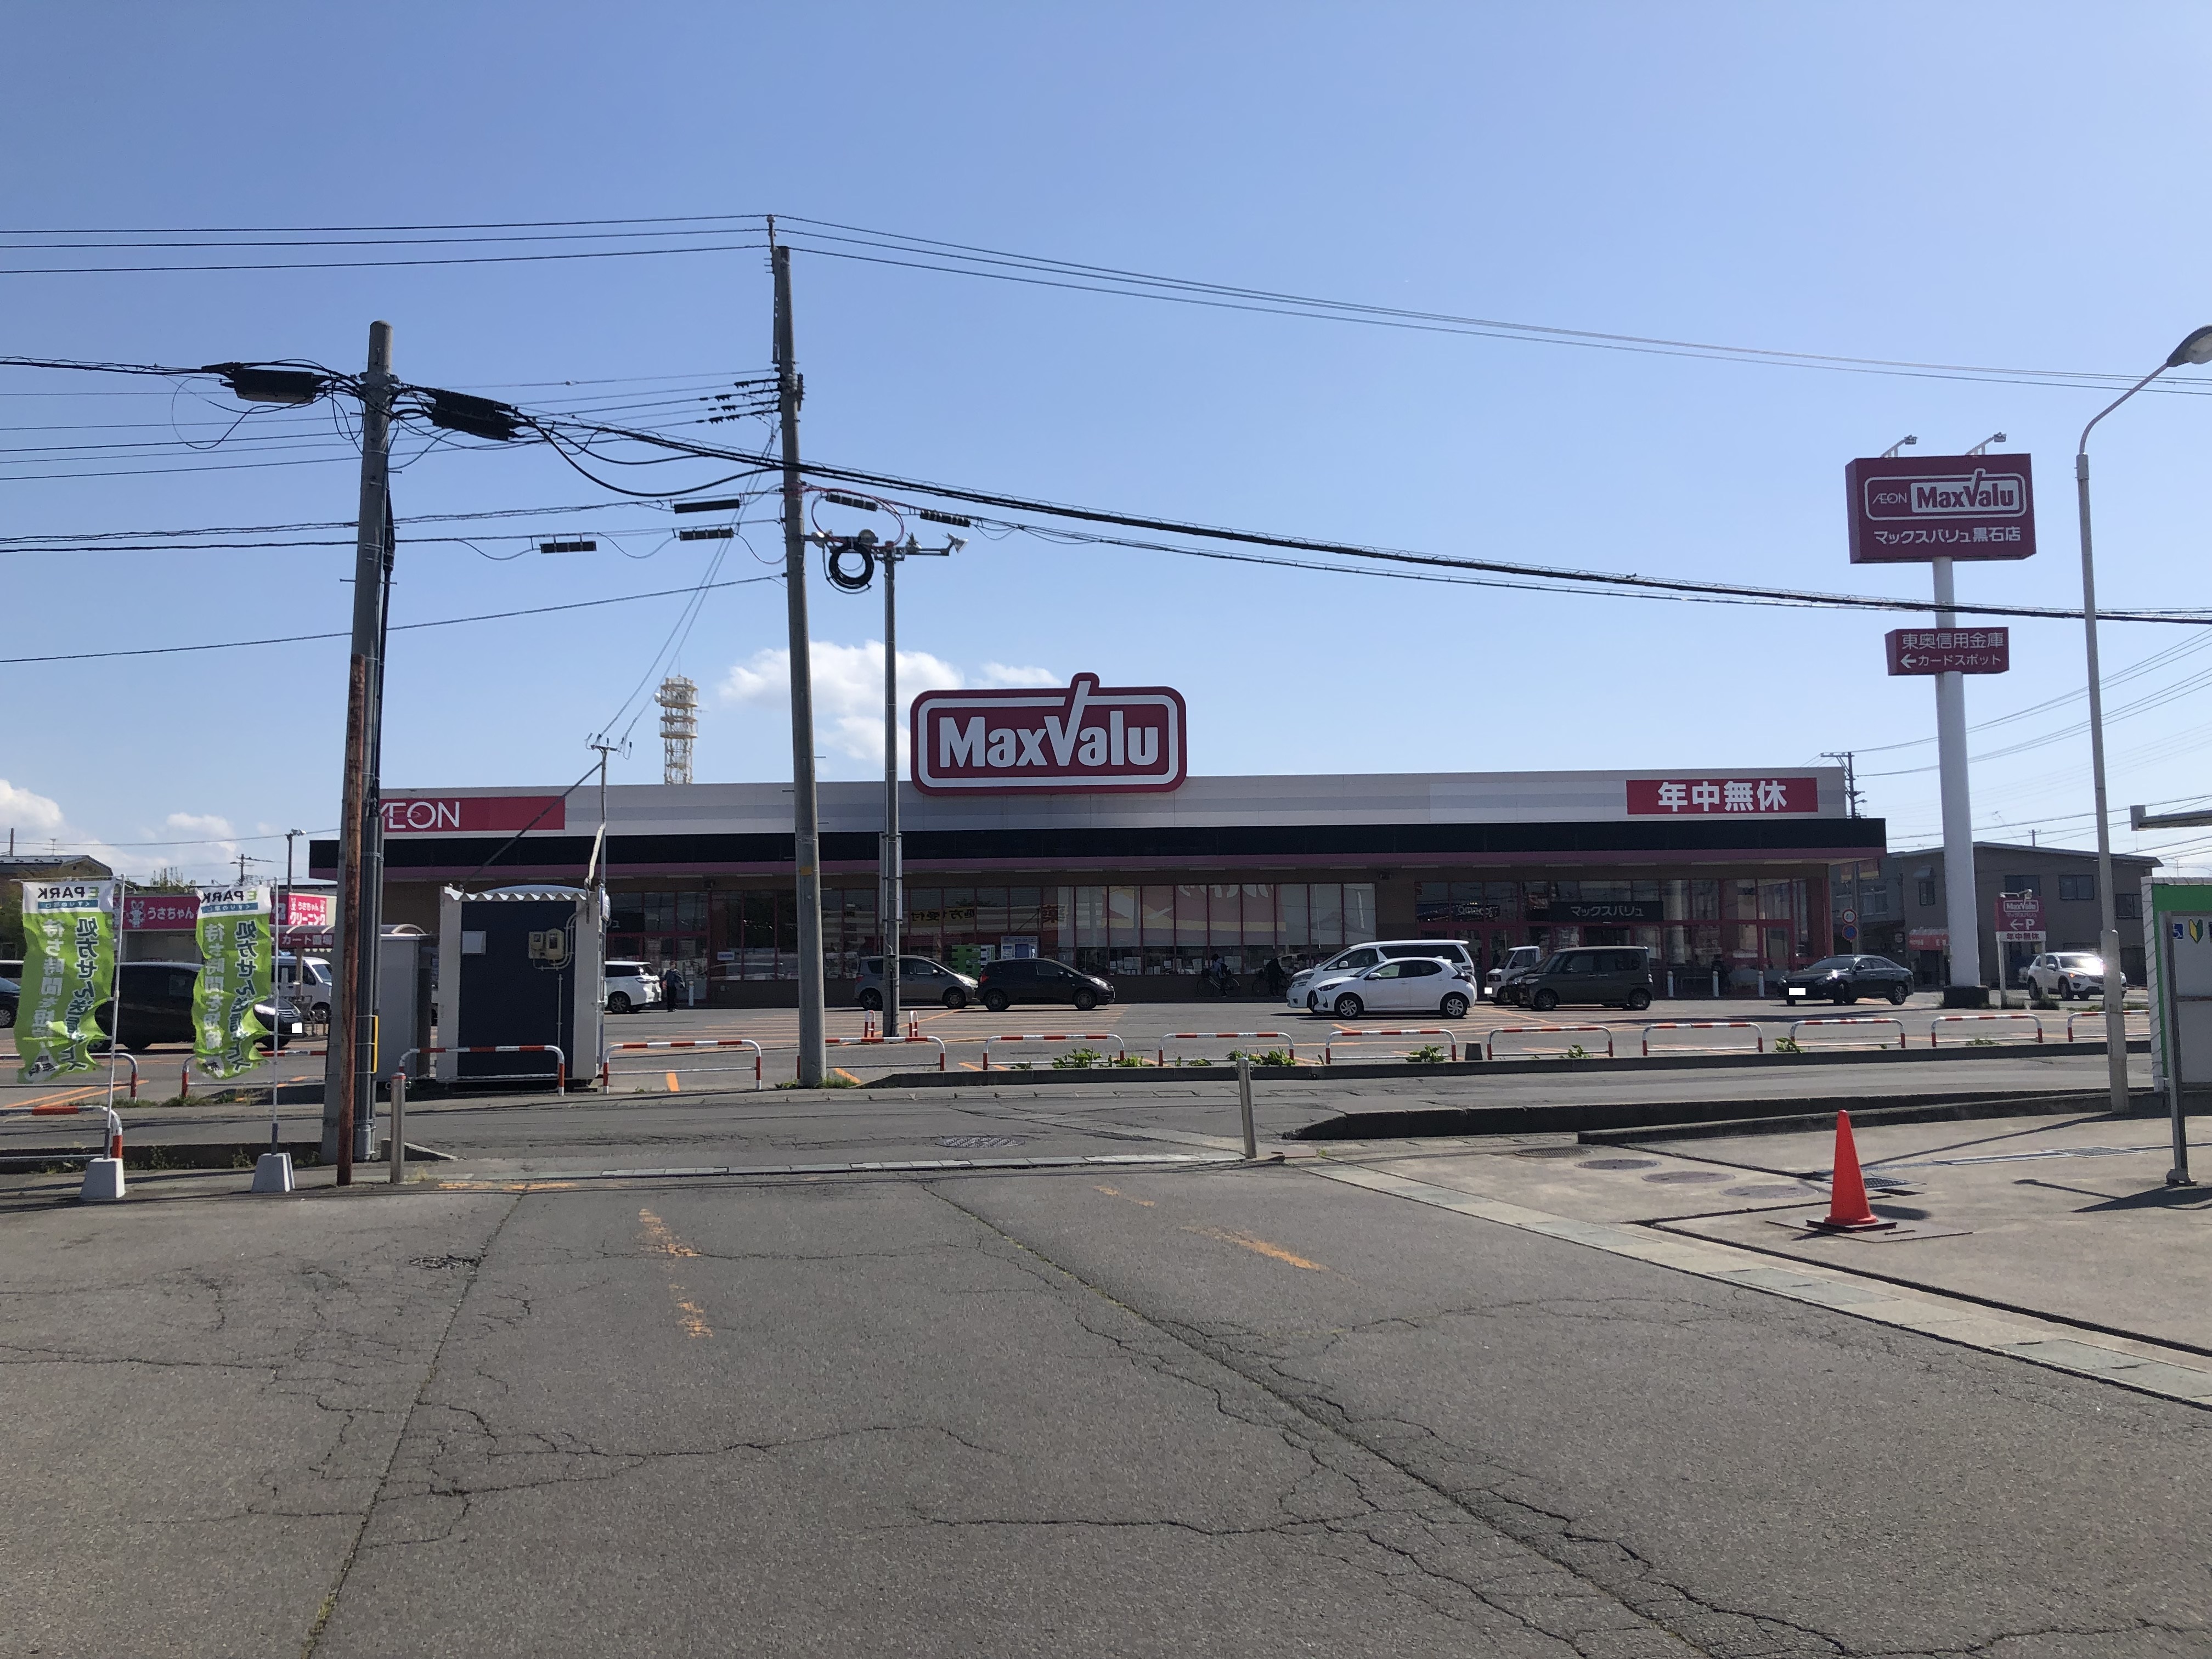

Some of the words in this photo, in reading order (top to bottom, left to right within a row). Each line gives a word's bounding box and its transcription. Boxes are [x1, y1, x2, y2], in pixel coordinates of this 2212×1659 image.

[1916, 470, 2014, 509] MaxValu
[1874, 527, 2021, 545] マックスバリュ黒石店
[1902, 633, 2004, 650] 東奥信用金庫
[939, 680, 1158, 768] MaxValu
[1658, 781, 1787, 812] 年中無休
[148, 907, 198, 920] うさちゃん
[1571, 906, 1644, 917] マックスバリュ
[2025, 918, 2035, 930] P
